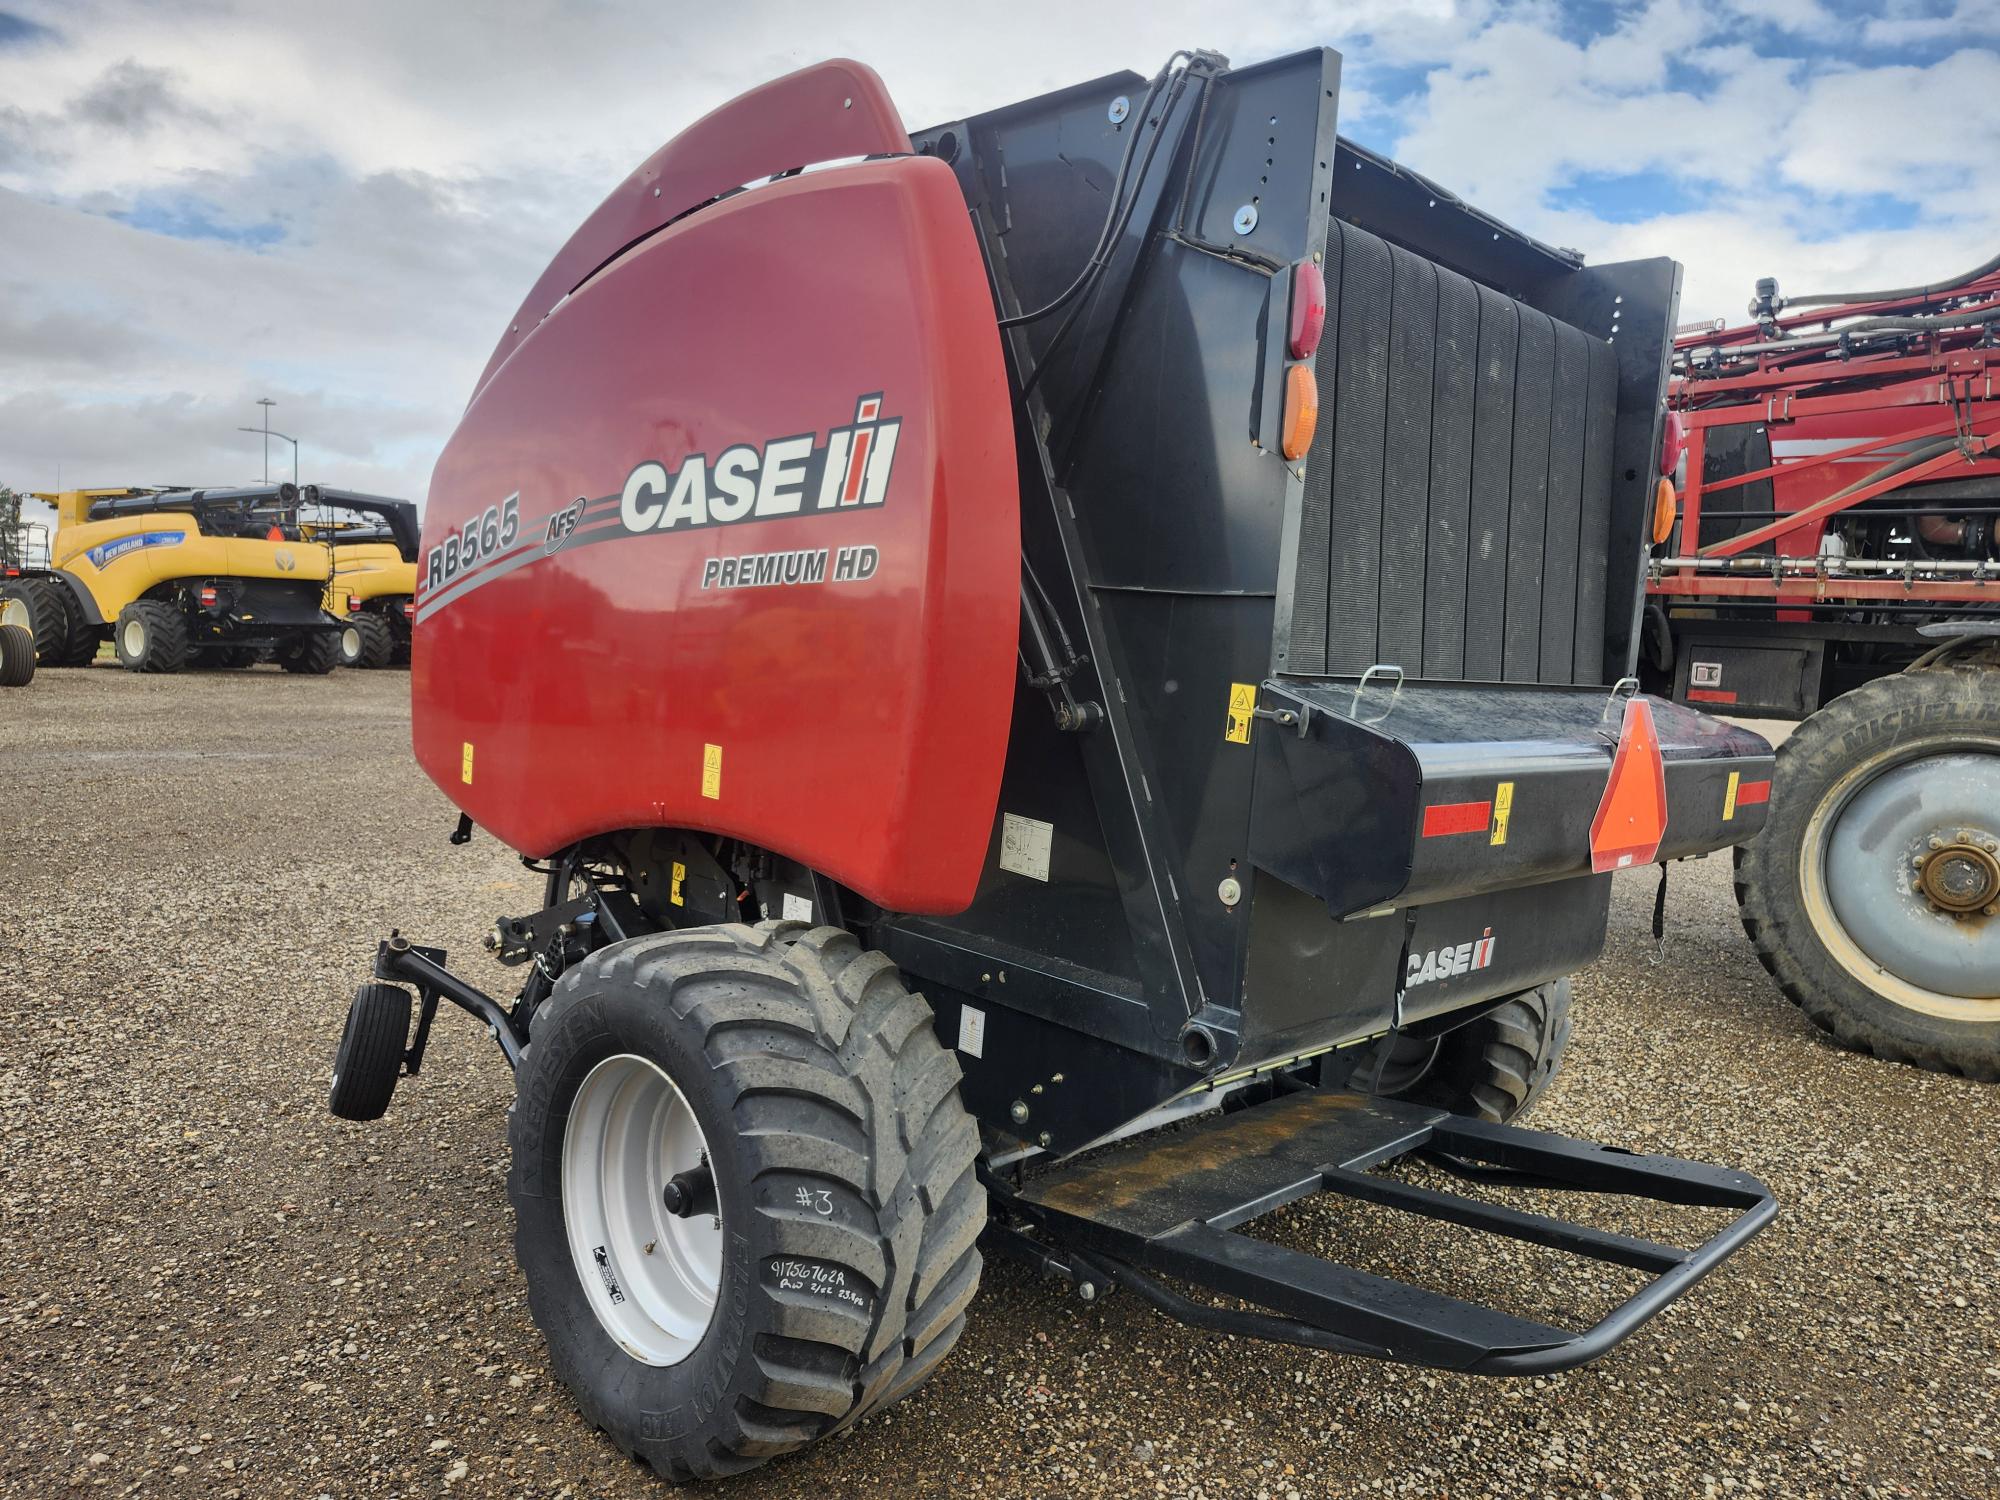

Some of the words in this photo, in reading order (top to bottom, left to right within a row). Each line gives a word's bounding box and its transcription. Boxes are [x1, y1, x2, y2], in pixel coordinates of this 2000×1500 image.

[620, 436, 814, 532] CASE
[428, 492, 519, 591] RB565
[545, 506, 577, 544] AFS
[105, 547, 118, 560] NEW
[118, 538, 143, 553] HOLLAND
[702, 550, 828, 588] PREMIUM
[833, 545, 879, 581] HD
[1842, 702, 2000, 752] MICHELIN
[1406, 942, 1472, 988] CASE
